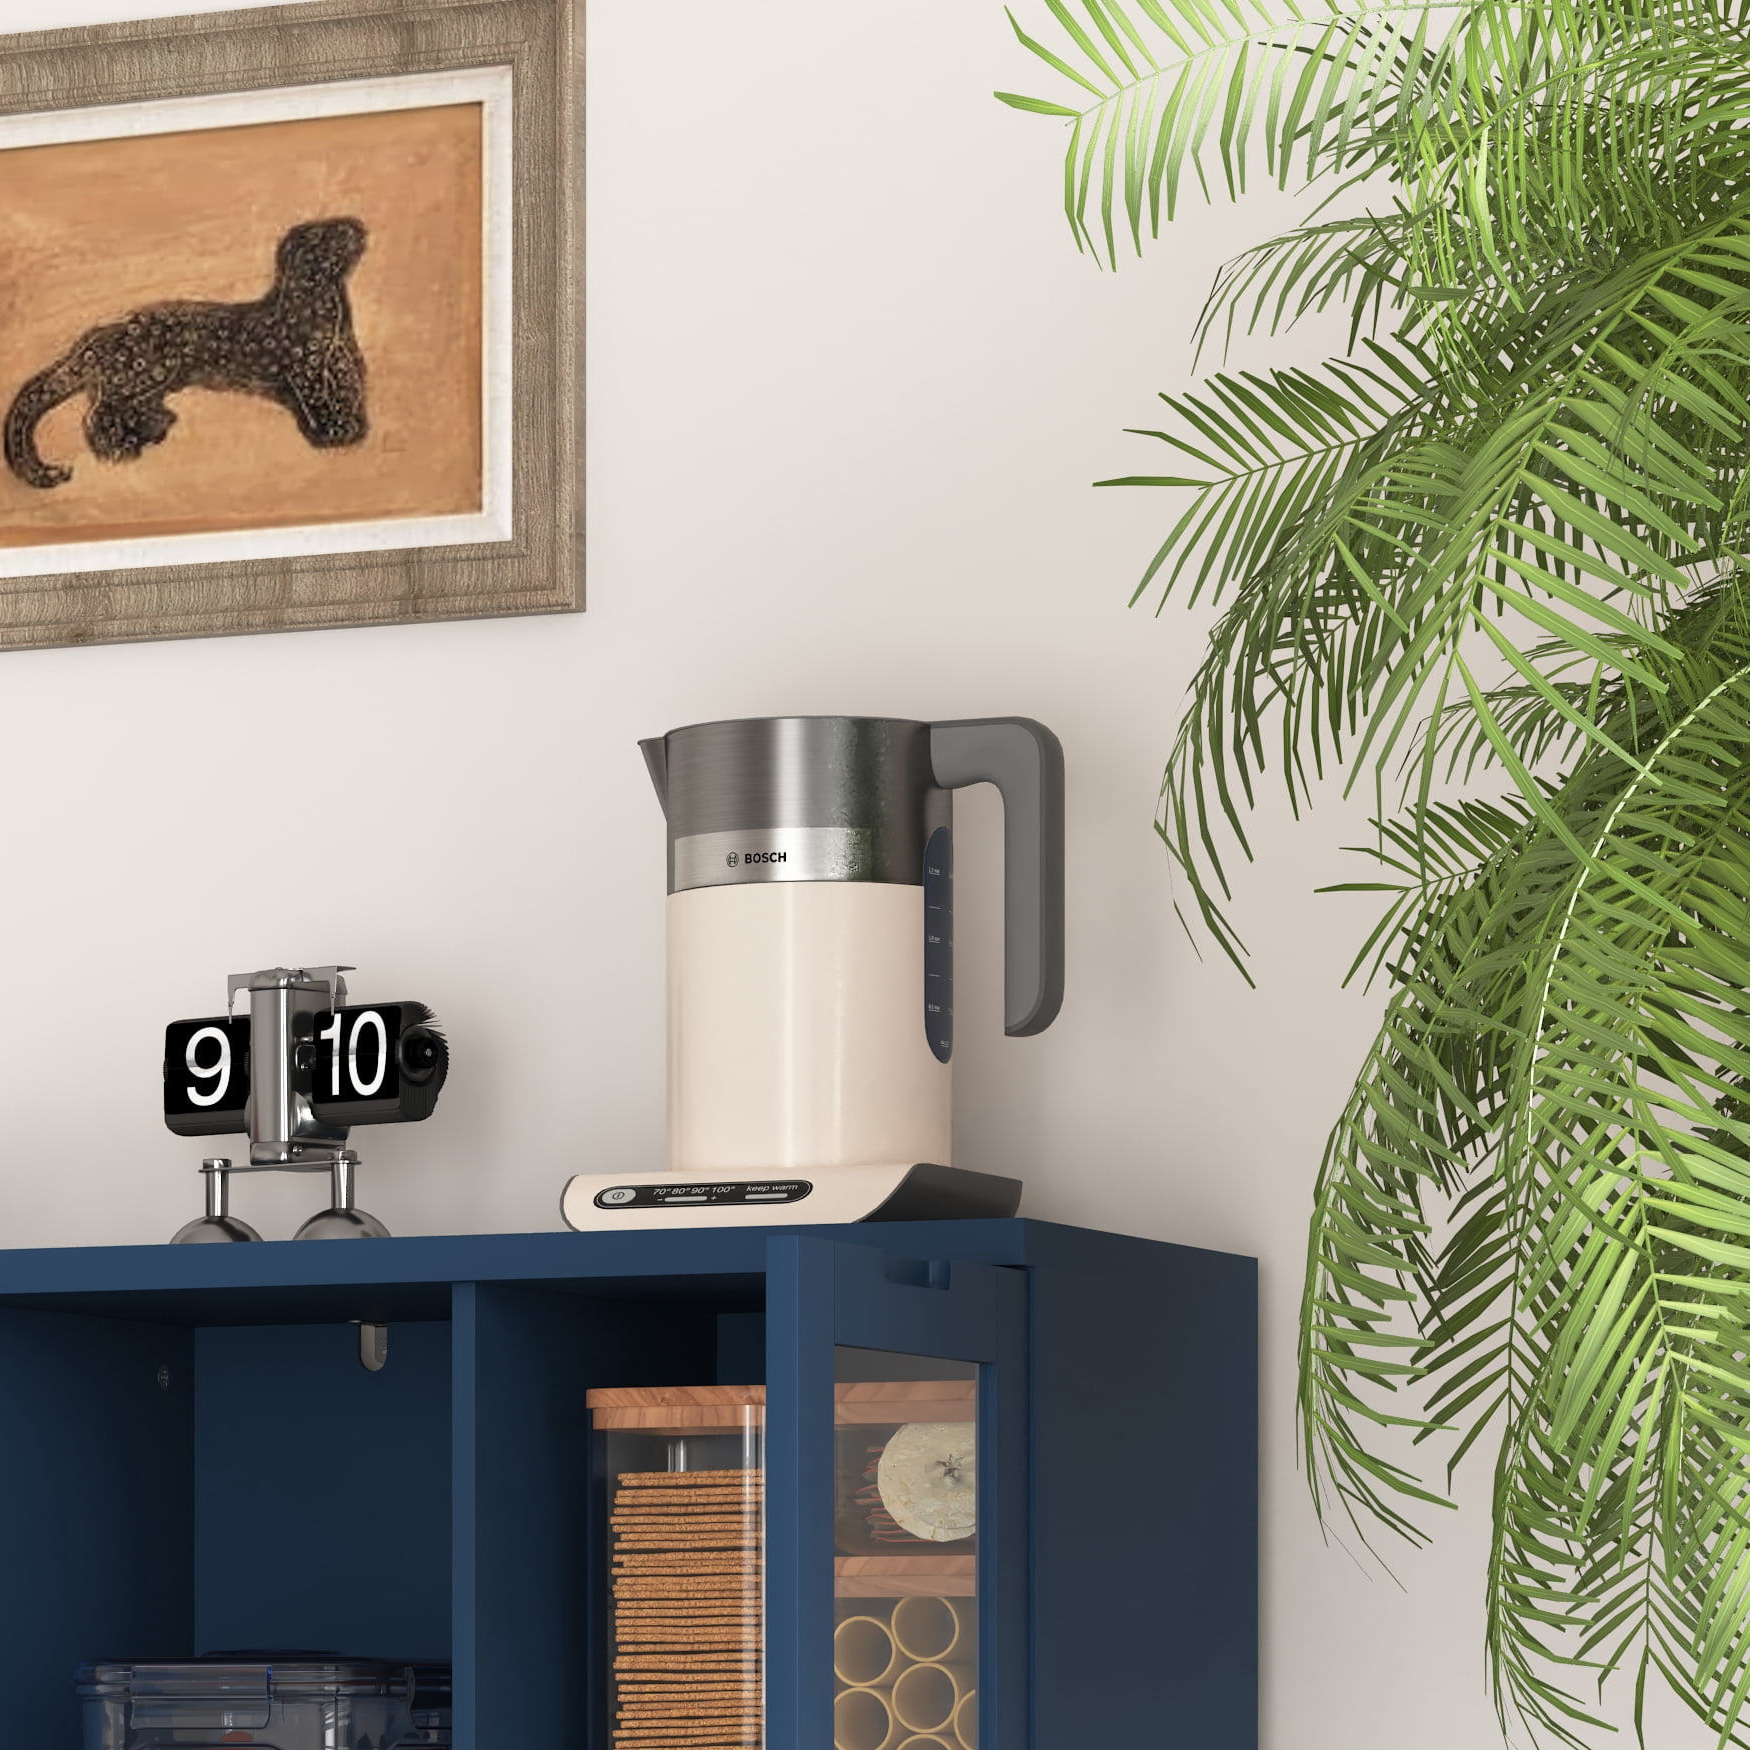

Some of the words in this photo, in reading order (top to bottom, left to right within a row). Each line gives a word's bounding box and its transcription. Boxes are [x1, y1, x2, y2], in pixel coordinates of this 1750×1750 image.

[744, 852, 787, 864] BOSCH
[185, 1026, 231, 1106] 9
[320, 1010, 387, 1096] 10
[746, 1185, 770, 1193] keep
